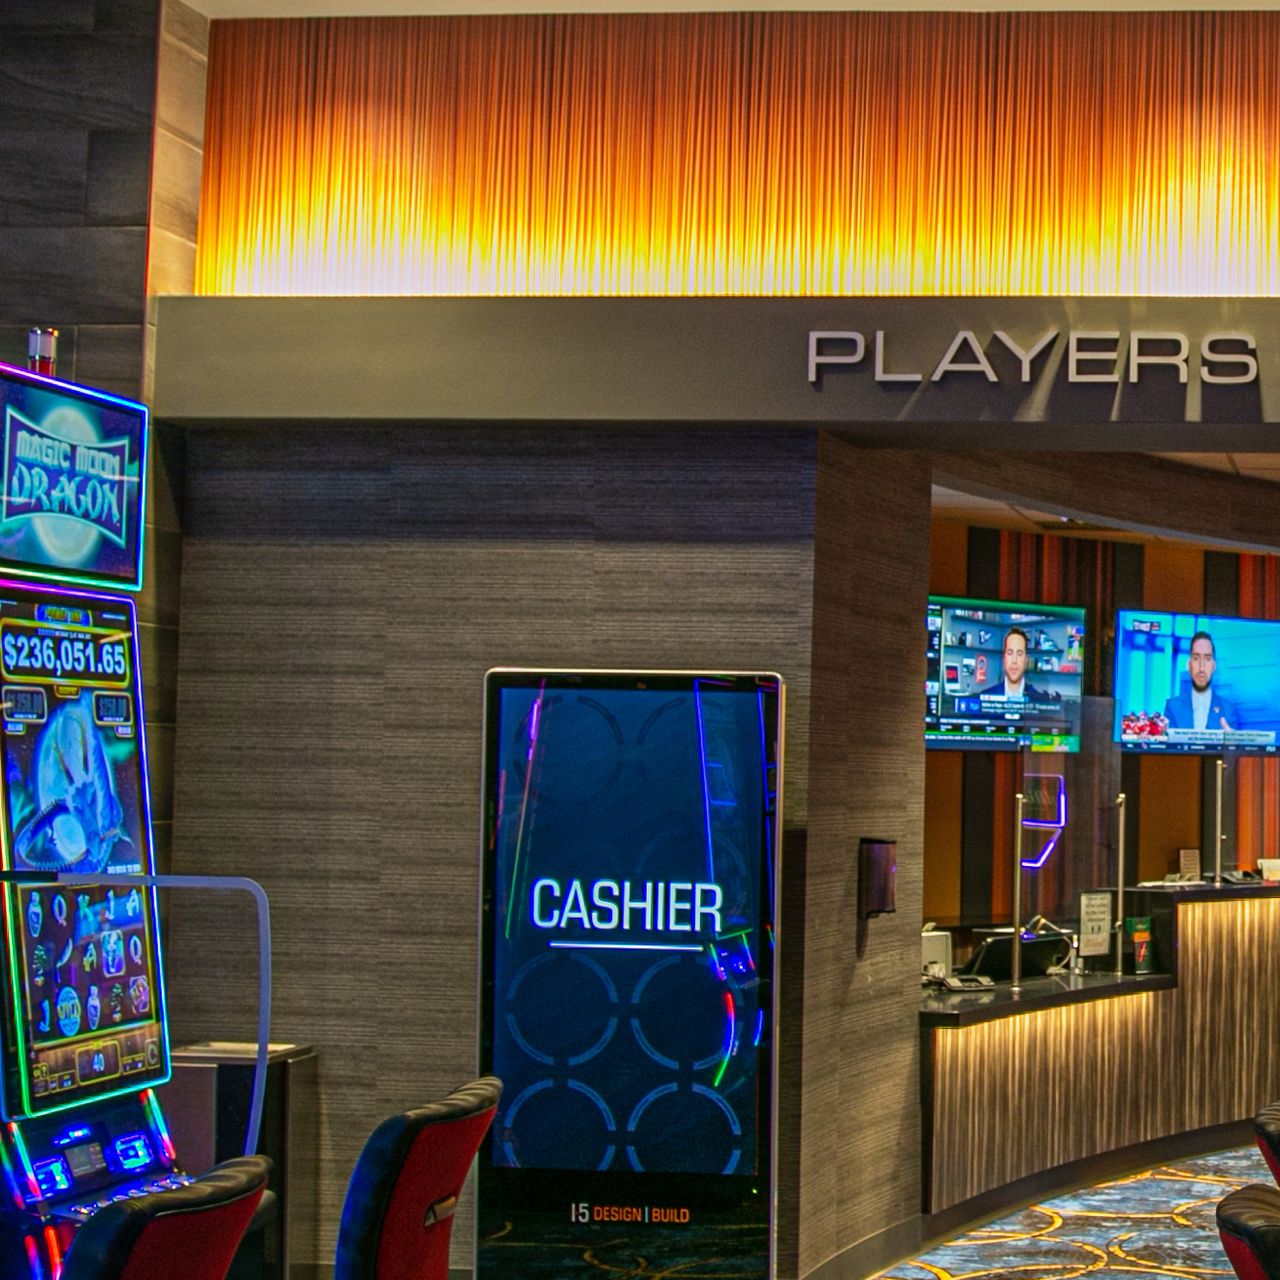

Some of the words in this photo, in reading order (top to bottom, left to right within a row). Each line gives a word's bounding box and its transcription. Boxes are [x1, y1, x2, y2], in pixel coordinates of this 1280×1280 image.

[806, 329, 1259, 385] PLAYERS
[16, 430, 71, 470] MAGIC
[76, 445, 120, 480] MOON
[11, 461, 120, 524] DRAGON
[4, 632, 125, 676] $236,051.65
[531, 878, 724, 933] CASHIER
[593, 1206, 643, 1222] DESIGN
[651, 1208, 690, 1223] BUILD
